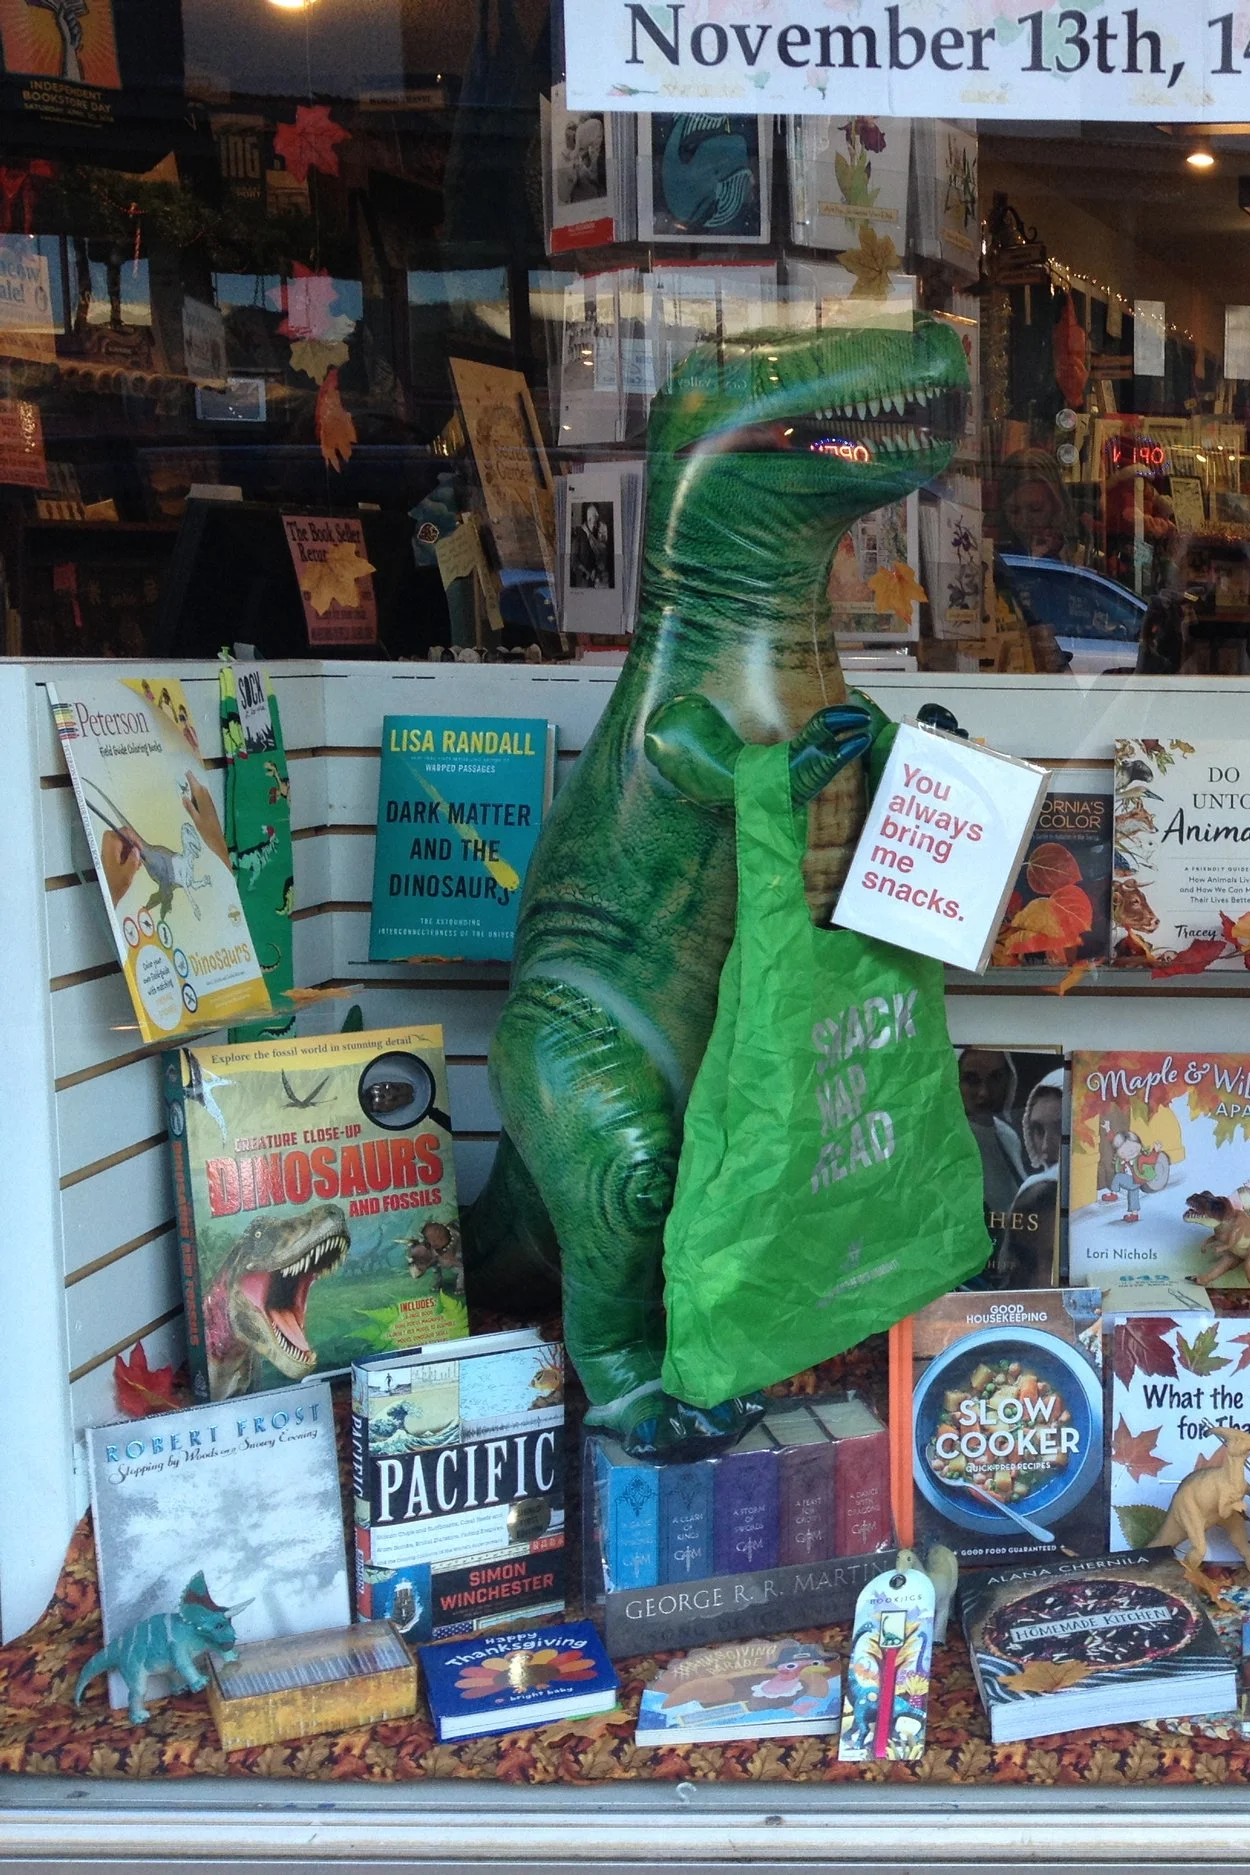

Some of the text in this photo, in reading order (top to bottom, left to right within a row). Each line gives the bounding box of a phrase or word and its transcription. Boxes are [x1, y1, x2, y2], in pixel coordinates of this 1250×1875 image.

[624, 3, 995, 71] November
[1018, 9, 1185, 89] 13th,
[22, 89, 111, 112] BOOKSTORE DAY
[30, 80, 103, 100] INDEPENDENT
[286, 520, 361, 543] The Book Seller
[238, 671, 265, 710] SOCK
[73, 702, 150, 738] Peterson
[390, 729, 535, 756] LISA RANDALL
[901, 762, 951, 803] You
[1208, 766, 1240, 783] DO
[386, 800, 531, 827] DARK MATTER
[887, 790, 984, 844] always
[1039, 814, 1101, 829] COLOR
[410, 838, 501, 862] AND THE
[878, 815, 953, 866] bring
[870, 844, 915, 874] me
[389, 874, 515, 907] DINOSAURS
[860, 867, 965, 923] snacks.
[1175, 924, 1217, 941] Tracey
[189, 943, 251, 977] Dinosaurs
[211, 1034, 412, 1066] Explore the fossil world in stunning detail
[1087, 1056, 1180, 1103] Maple
[1184, 1061, 1211, 1085] &
[815, 1063, 867, 1137] NAP
[235, 1123, 362, 1152] CREATURE CLOSE-UP
[205, 1132, 444, 1218] DINOSAURS
[349, 1188, 442, 1218] AND FOSSILS
[1086, 1248, 1158, 1260] Lori Nichols
[966, 1311, 1048, 1324] HOUSEKEEPING
[990, 1304, 1025, 1315] GOOD
[958, 1396, 1056, 1427] SLOW
[1142, 1383, 1205, 1410] What
[1209, 1386, 1244, 1410] the
[105, 1403, 320, 1464] ROBERT FROST
[1177, 1414, 1209, 1441] for
[108, 1460, 164, 1486] Stopping
[167, 1454, 181, 1469] by
[184, 1446, 220, 1463] Woods
[237, 1435, 276, 1452] Snowy
[278, 1428, 319, 1443] Evening
[935, 1429, 1080, 1462] COOKER
[376, 1429, 556, 1523] PACIFIC
[965, 1461, 1051, 1473] QUICK-PREP RECIPES
[469, 1561, 528, 1586] SIMON
[987, 1556, 1150, 1585] ALANA CHERNILA
[440, 1573, 555, 1611] WINCHESTER
[625, 1559, 888, 1620] GEORGE R. R. MARTIN
[485, 1631, 538, 1645] Happy
[1015, 1607, 1167, 1641] HOMEMADE KITCHEN
[444, 1637, 588, 1667] Thanksgiving
[673, 1643, 777, 1677] THANKSGIVING
[708, 1656, 761, 1674] PARADE
